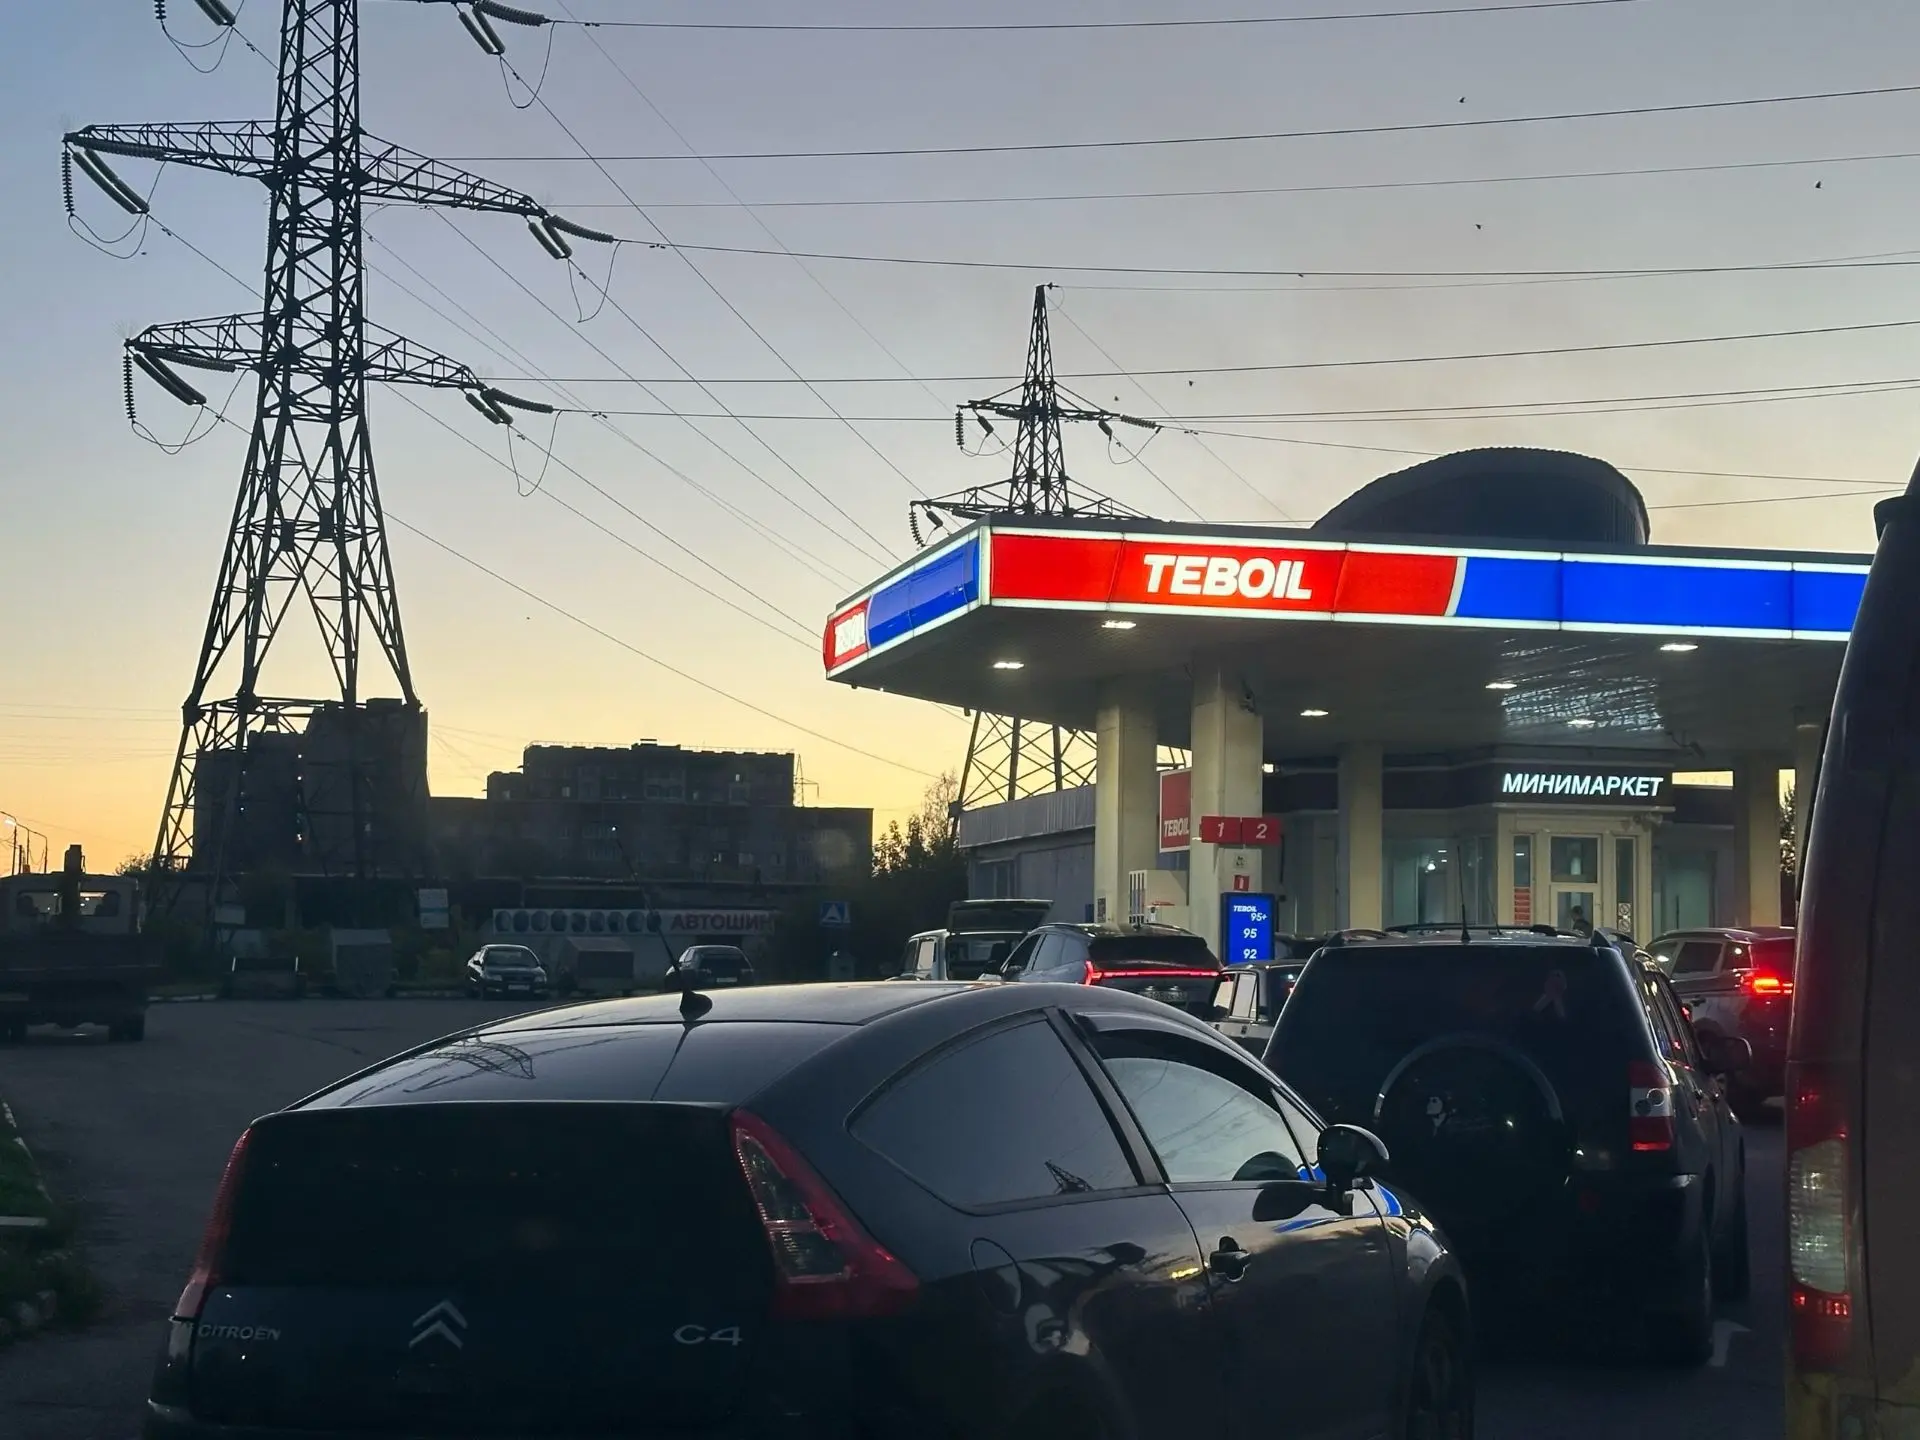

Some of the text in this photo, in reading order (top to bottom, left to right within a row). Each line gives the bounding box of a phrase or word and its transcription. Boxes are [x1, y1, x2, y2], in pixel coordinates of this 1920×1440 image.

[1143, 554, 1313, 600] TEBOIL
[1502, 773, 1664, 797] МИНИМАРКЕТ
[1163, 817, 1190, 838] TEBOIL
[1217, 822, 1225, 838] 1
[1255, 823, 1268, 839] 2
[1233, 905, 1257, 913] TEBOIL
[1250, 913, 1267, 922] 95+
[1243, 928, 1257, 939] 95
[1243, 948, 1257, 959] 92
[672, 1324, 743, 1346] C4
